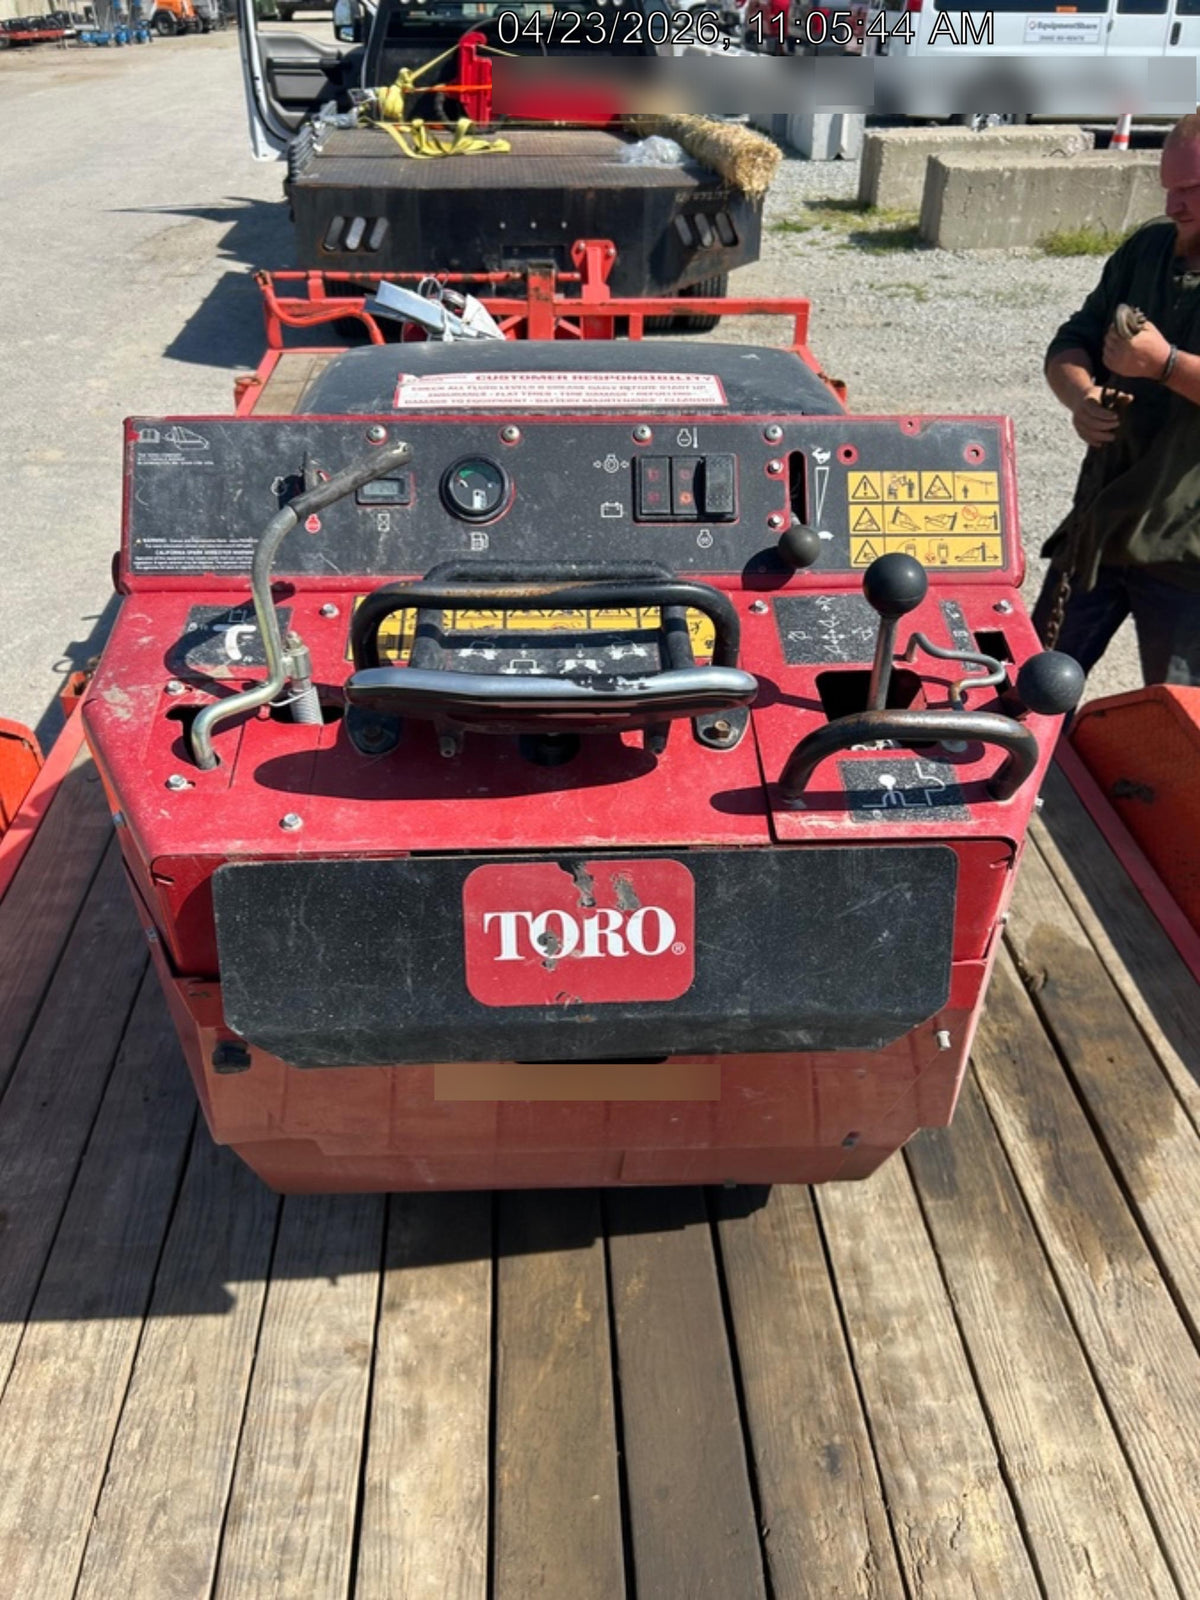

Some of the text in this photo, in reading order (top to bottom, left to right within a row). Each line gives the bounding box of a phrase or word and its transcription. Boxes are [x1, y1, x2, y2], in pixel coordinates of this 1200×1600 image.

[1038, 21, 1098, 31] EquipmentShare
[572, 374, 711, 382] RESPONSIBILITY
[483, 905, 677, 963] TORO
